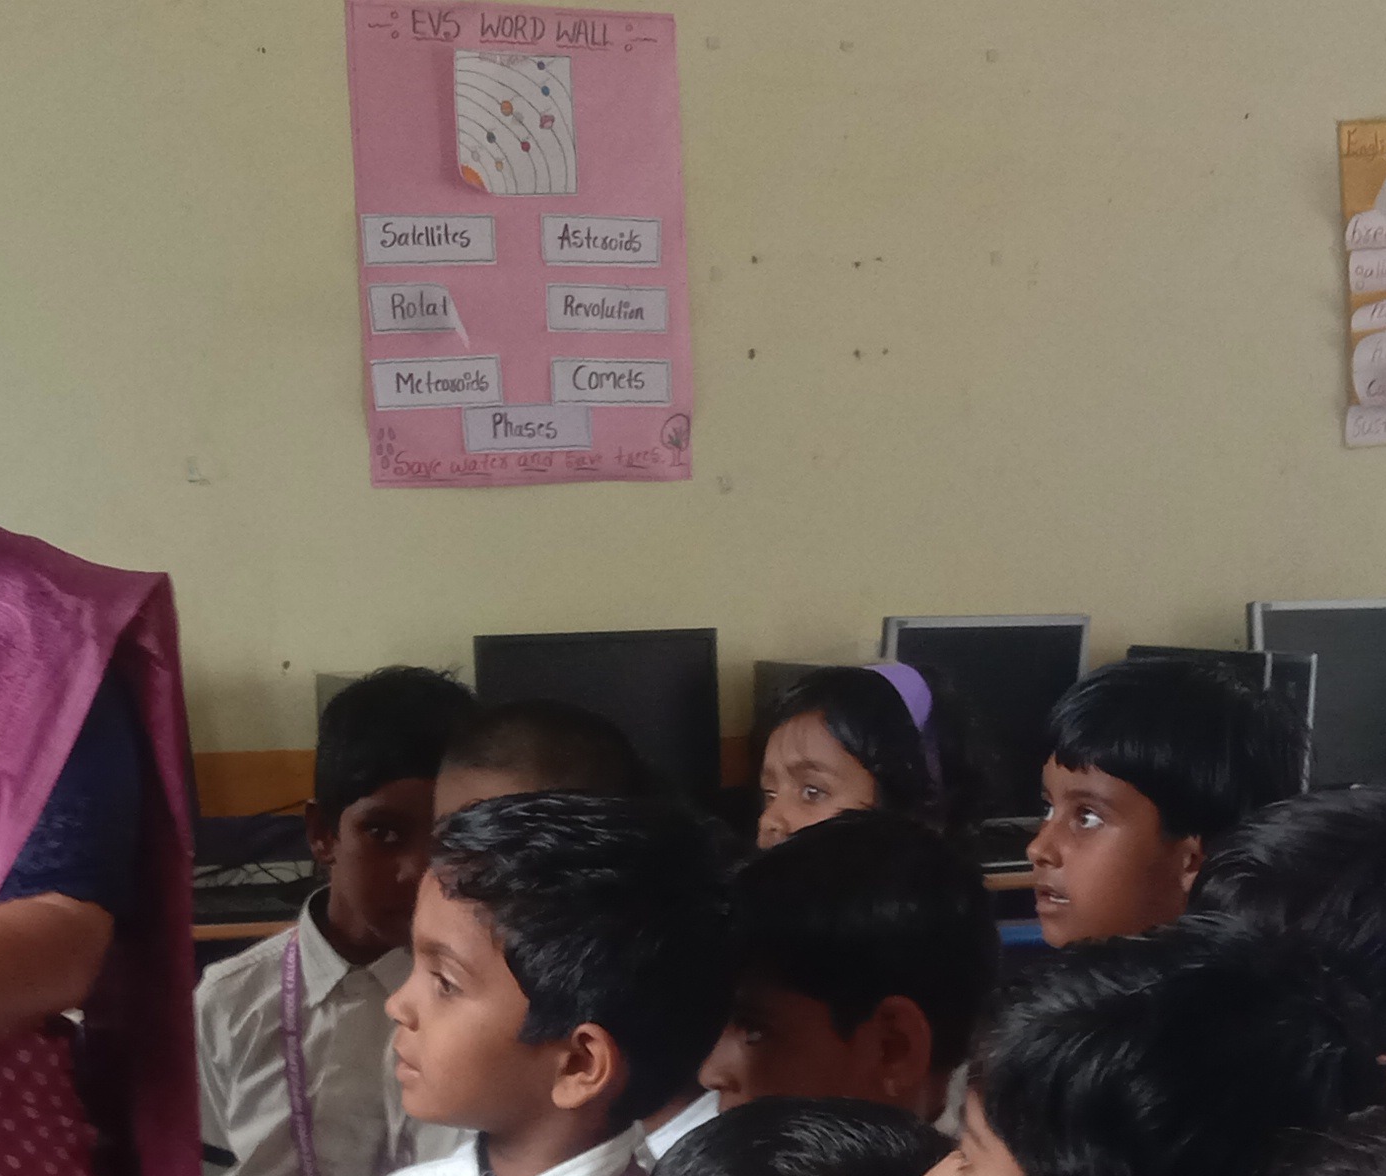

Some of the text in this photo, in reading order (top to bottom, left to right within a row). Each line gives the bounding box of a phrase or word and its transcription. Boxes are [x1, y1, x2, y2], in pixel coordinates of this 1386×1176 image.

[480, 12, 546, 41] WORD
[555, 21, 613, 46] WALL
[380, 222, 471, 248] Satellites
[557, 223, 643, 253] Asteroids
[563, 294, 645, 321] Revolution
[572, 365, 646, 391] Comets
[492, 412, 558, 440] Phases
[517, 450, 554, 468] and
